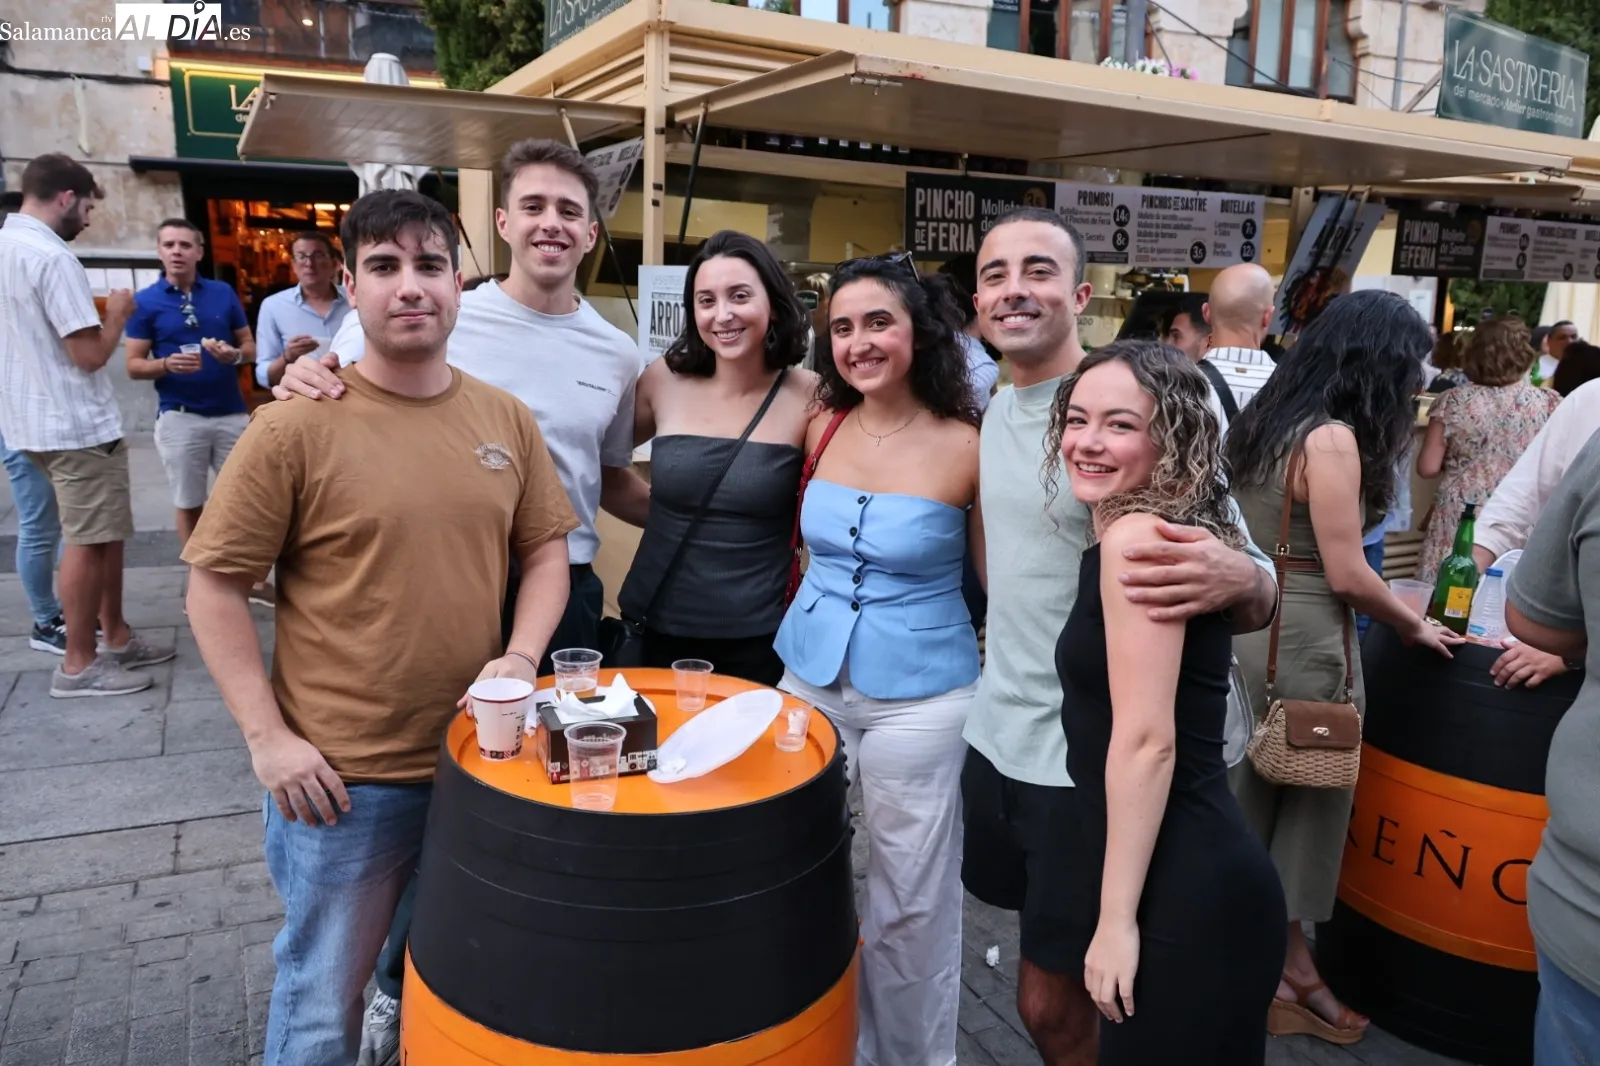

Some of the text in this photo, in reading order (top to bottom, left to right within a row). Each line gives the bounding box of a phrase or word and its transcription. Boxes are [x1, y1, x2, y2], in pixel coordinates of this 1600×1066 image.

[1453, 40, 1576, 112] LA SASTRERIA
[1453, 84, 1466, 97] del
[915, 187, 976, 220] PINCHO
[1077, 189, 1114, 208] PROMOS!
[915, 221, 977, 253] DE FERIA
[1403, 219, 1440, 244] PINCHO
[1408, 245, 1437, 269] FERIA
